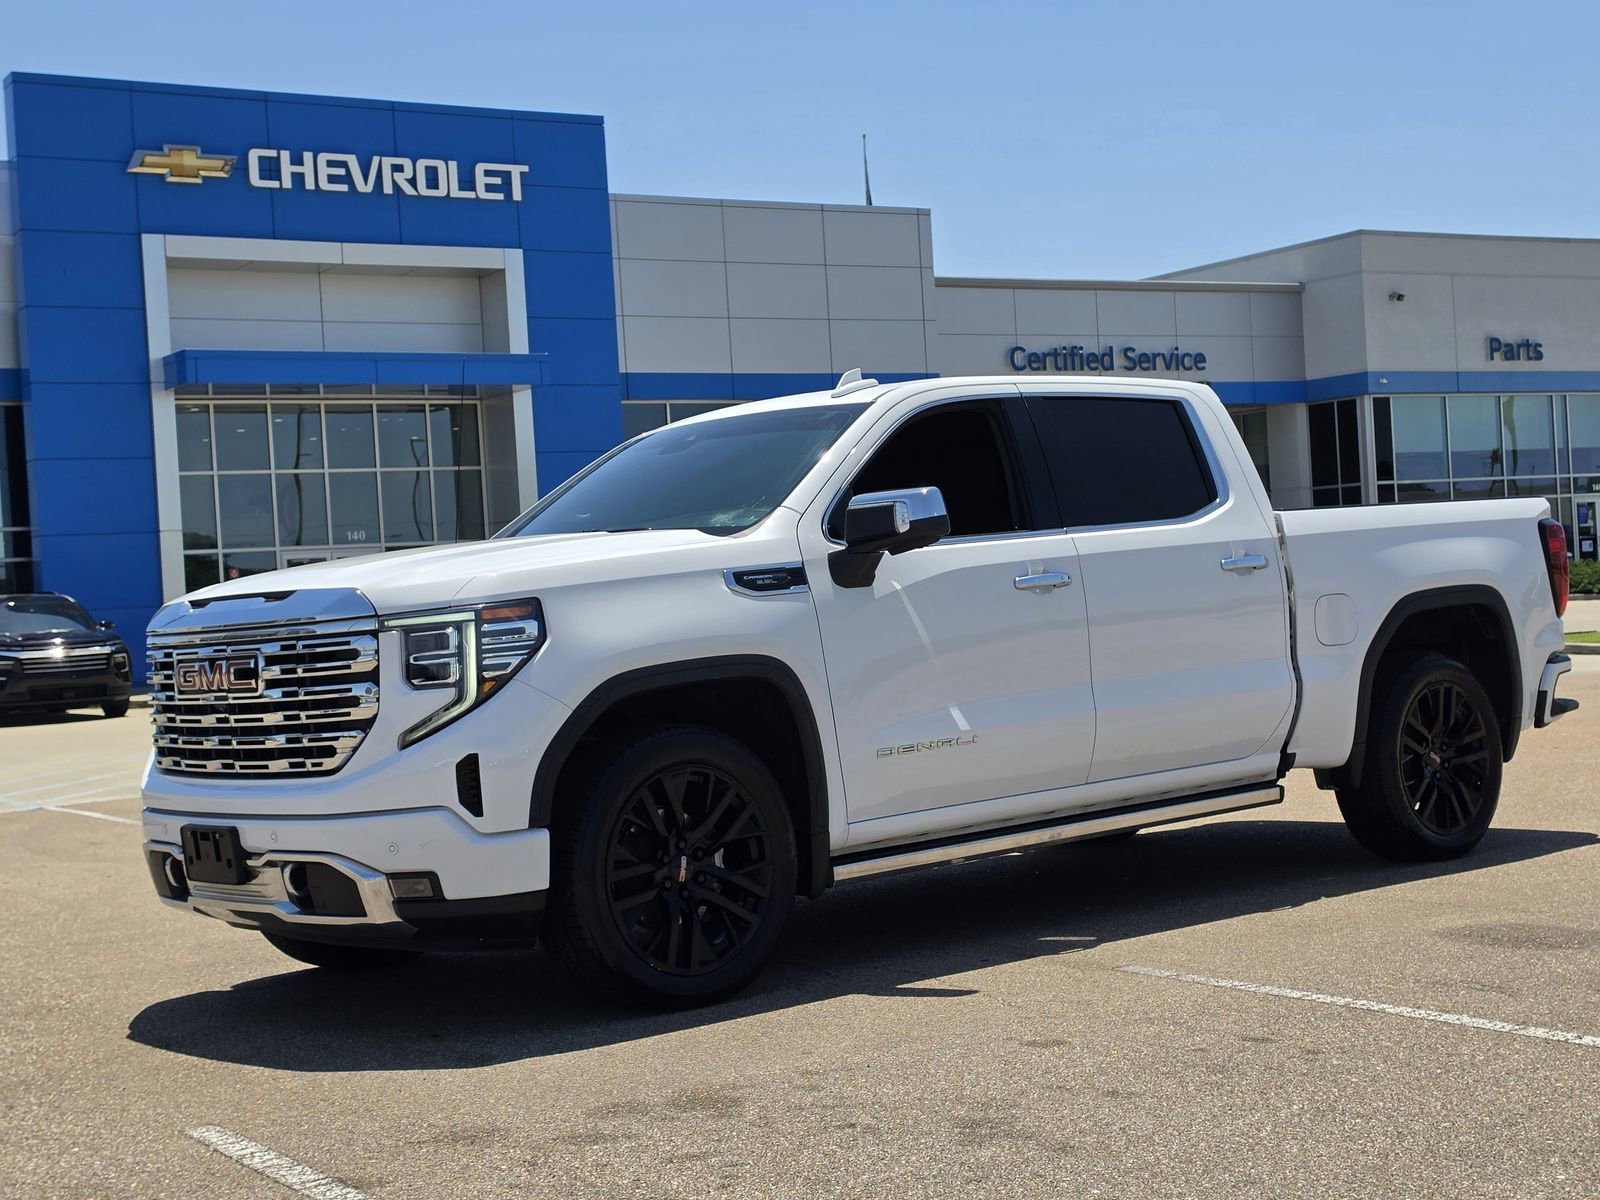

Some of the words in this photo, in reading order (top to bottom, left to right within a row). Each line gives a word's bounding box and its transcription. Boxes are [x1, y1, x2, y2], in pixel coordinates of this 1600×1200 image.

[247, 147, 530, 201] CHEVROLET
[1009, 345, 1115, 372] Certified
[1121, 346, 1207, 372] Service
[1488, 336, 1544, 361] Parts
[346, 530, 366, 541] 140
[176, 659, 257, 691] GMC
[877, 734, 979, 760] DENALI
